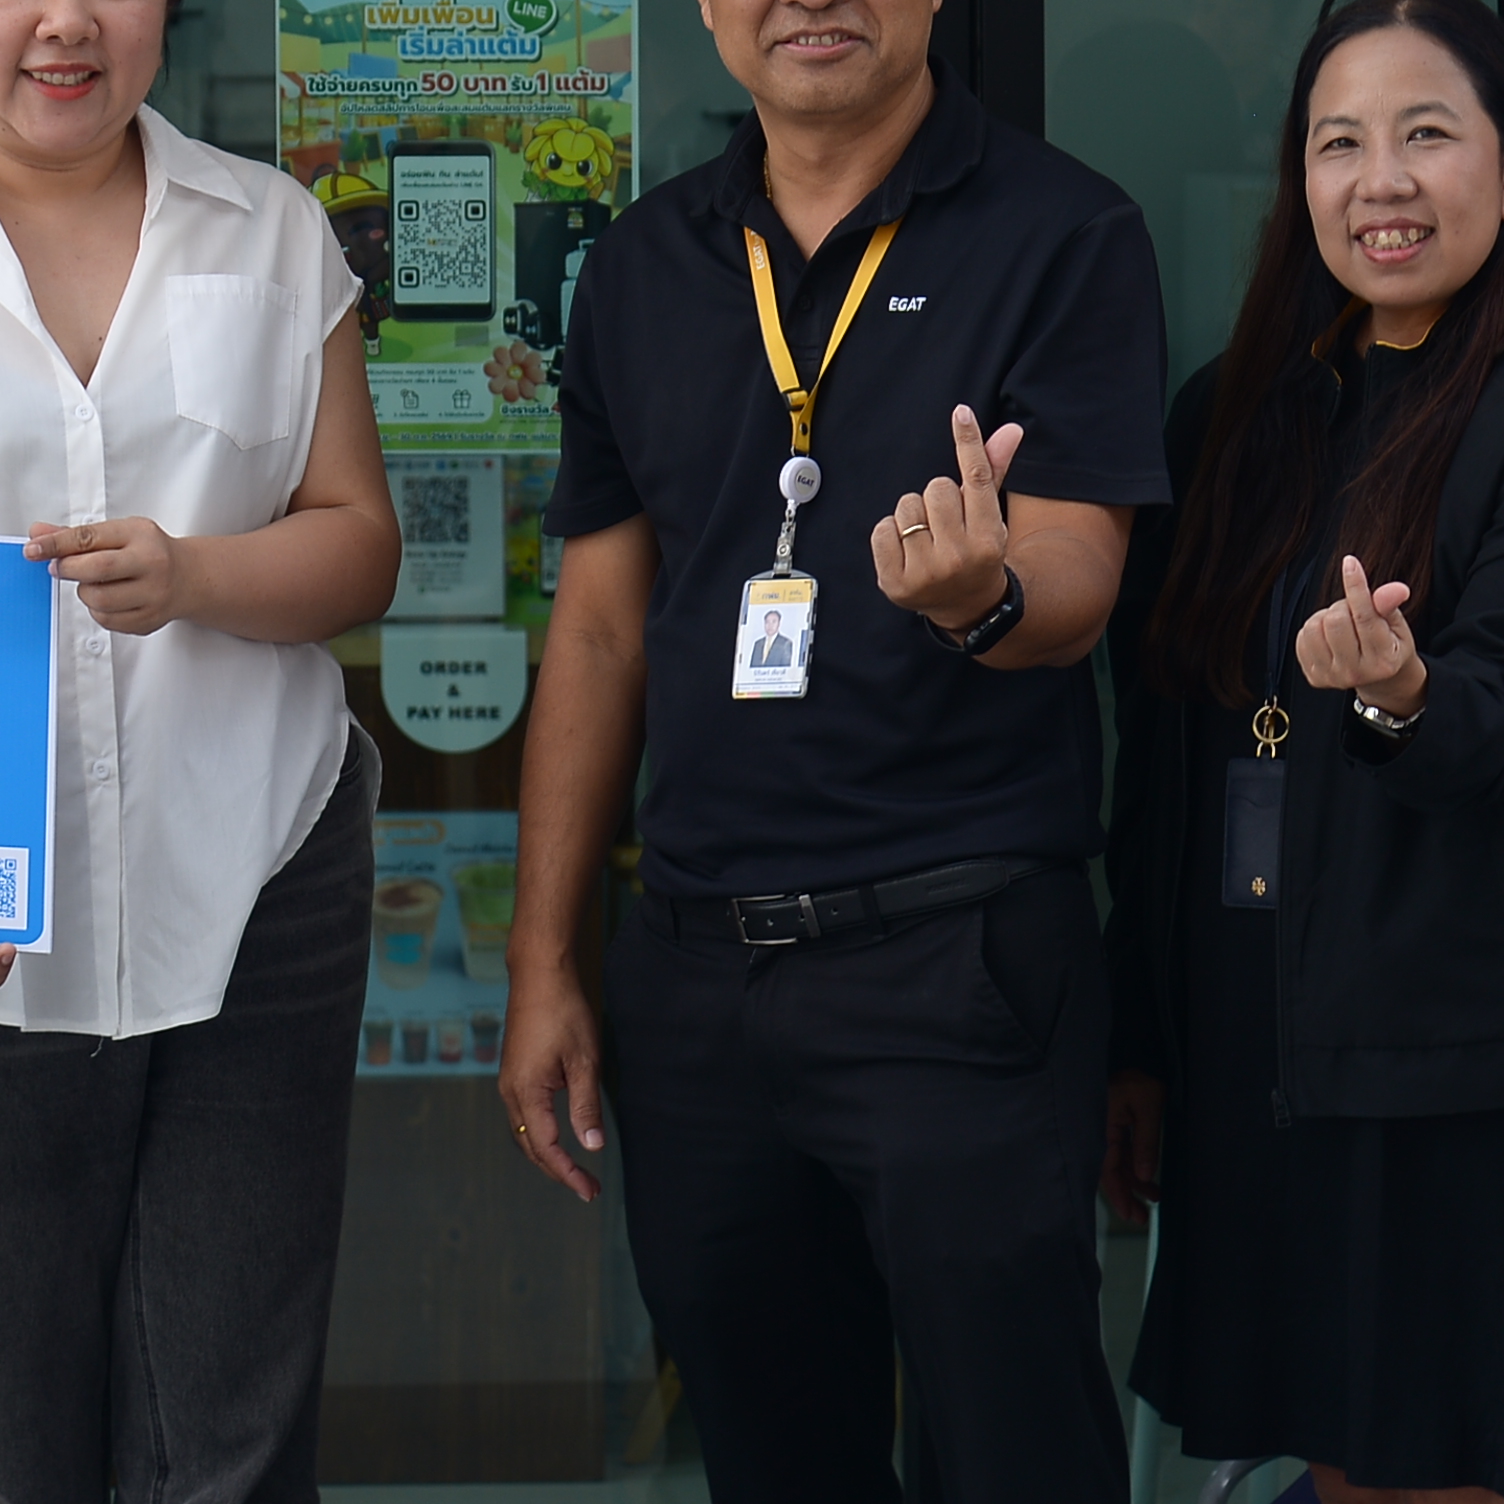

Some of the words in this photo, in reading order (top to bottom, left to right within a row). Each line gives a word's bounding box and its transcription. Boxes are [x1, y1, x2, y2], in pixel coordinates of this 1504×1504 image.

[513, 1, 548, 19] LINE
[399, 29, 539, 58] เริ่มล่าแต้ม
[307, 74, 418, 98] ใช้จ่ายครบทุก
[422, 72, 455, 93] 50
[464, 75, 507, 93] บาท
[512, 75, 533, 93] รับ
[536, 73, 549, 93] 1
[556, 70, 606, 92] แต้ม
[888, 295, 927, 312] EGAT
[797, 474, 815, 487] EGAT
[420, 661, 488, 675] ORDER
[407, 706, 444, 720] PAY
[448, 706, 501, 720] HERE
